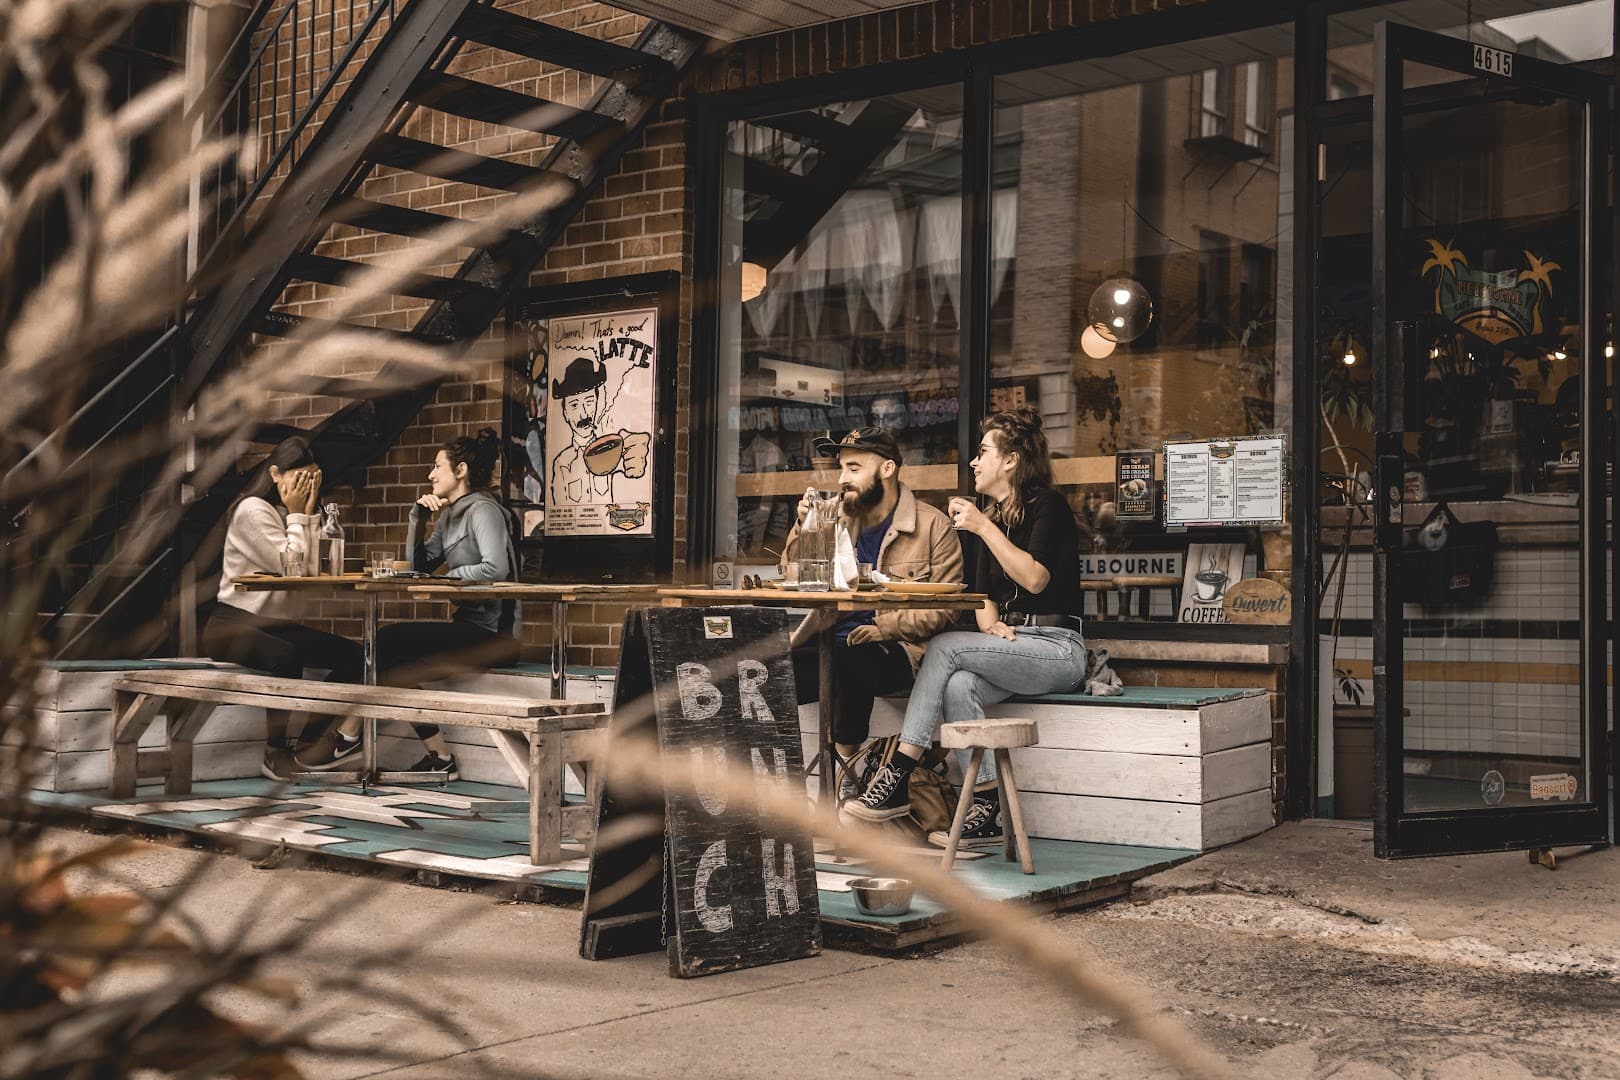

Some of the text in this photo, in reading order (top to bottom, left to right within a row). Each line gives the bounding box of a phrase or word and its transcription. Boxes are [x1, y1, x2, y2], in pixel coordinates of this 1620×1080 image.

[1475, 47, 1511, 75] 4615
[554, 320, 585, 343] Damn!
[625, 317, 648, 336] good
[599, 337, 654, 368] LATTE
[1231, 593, 1288, 613] Ouvert
